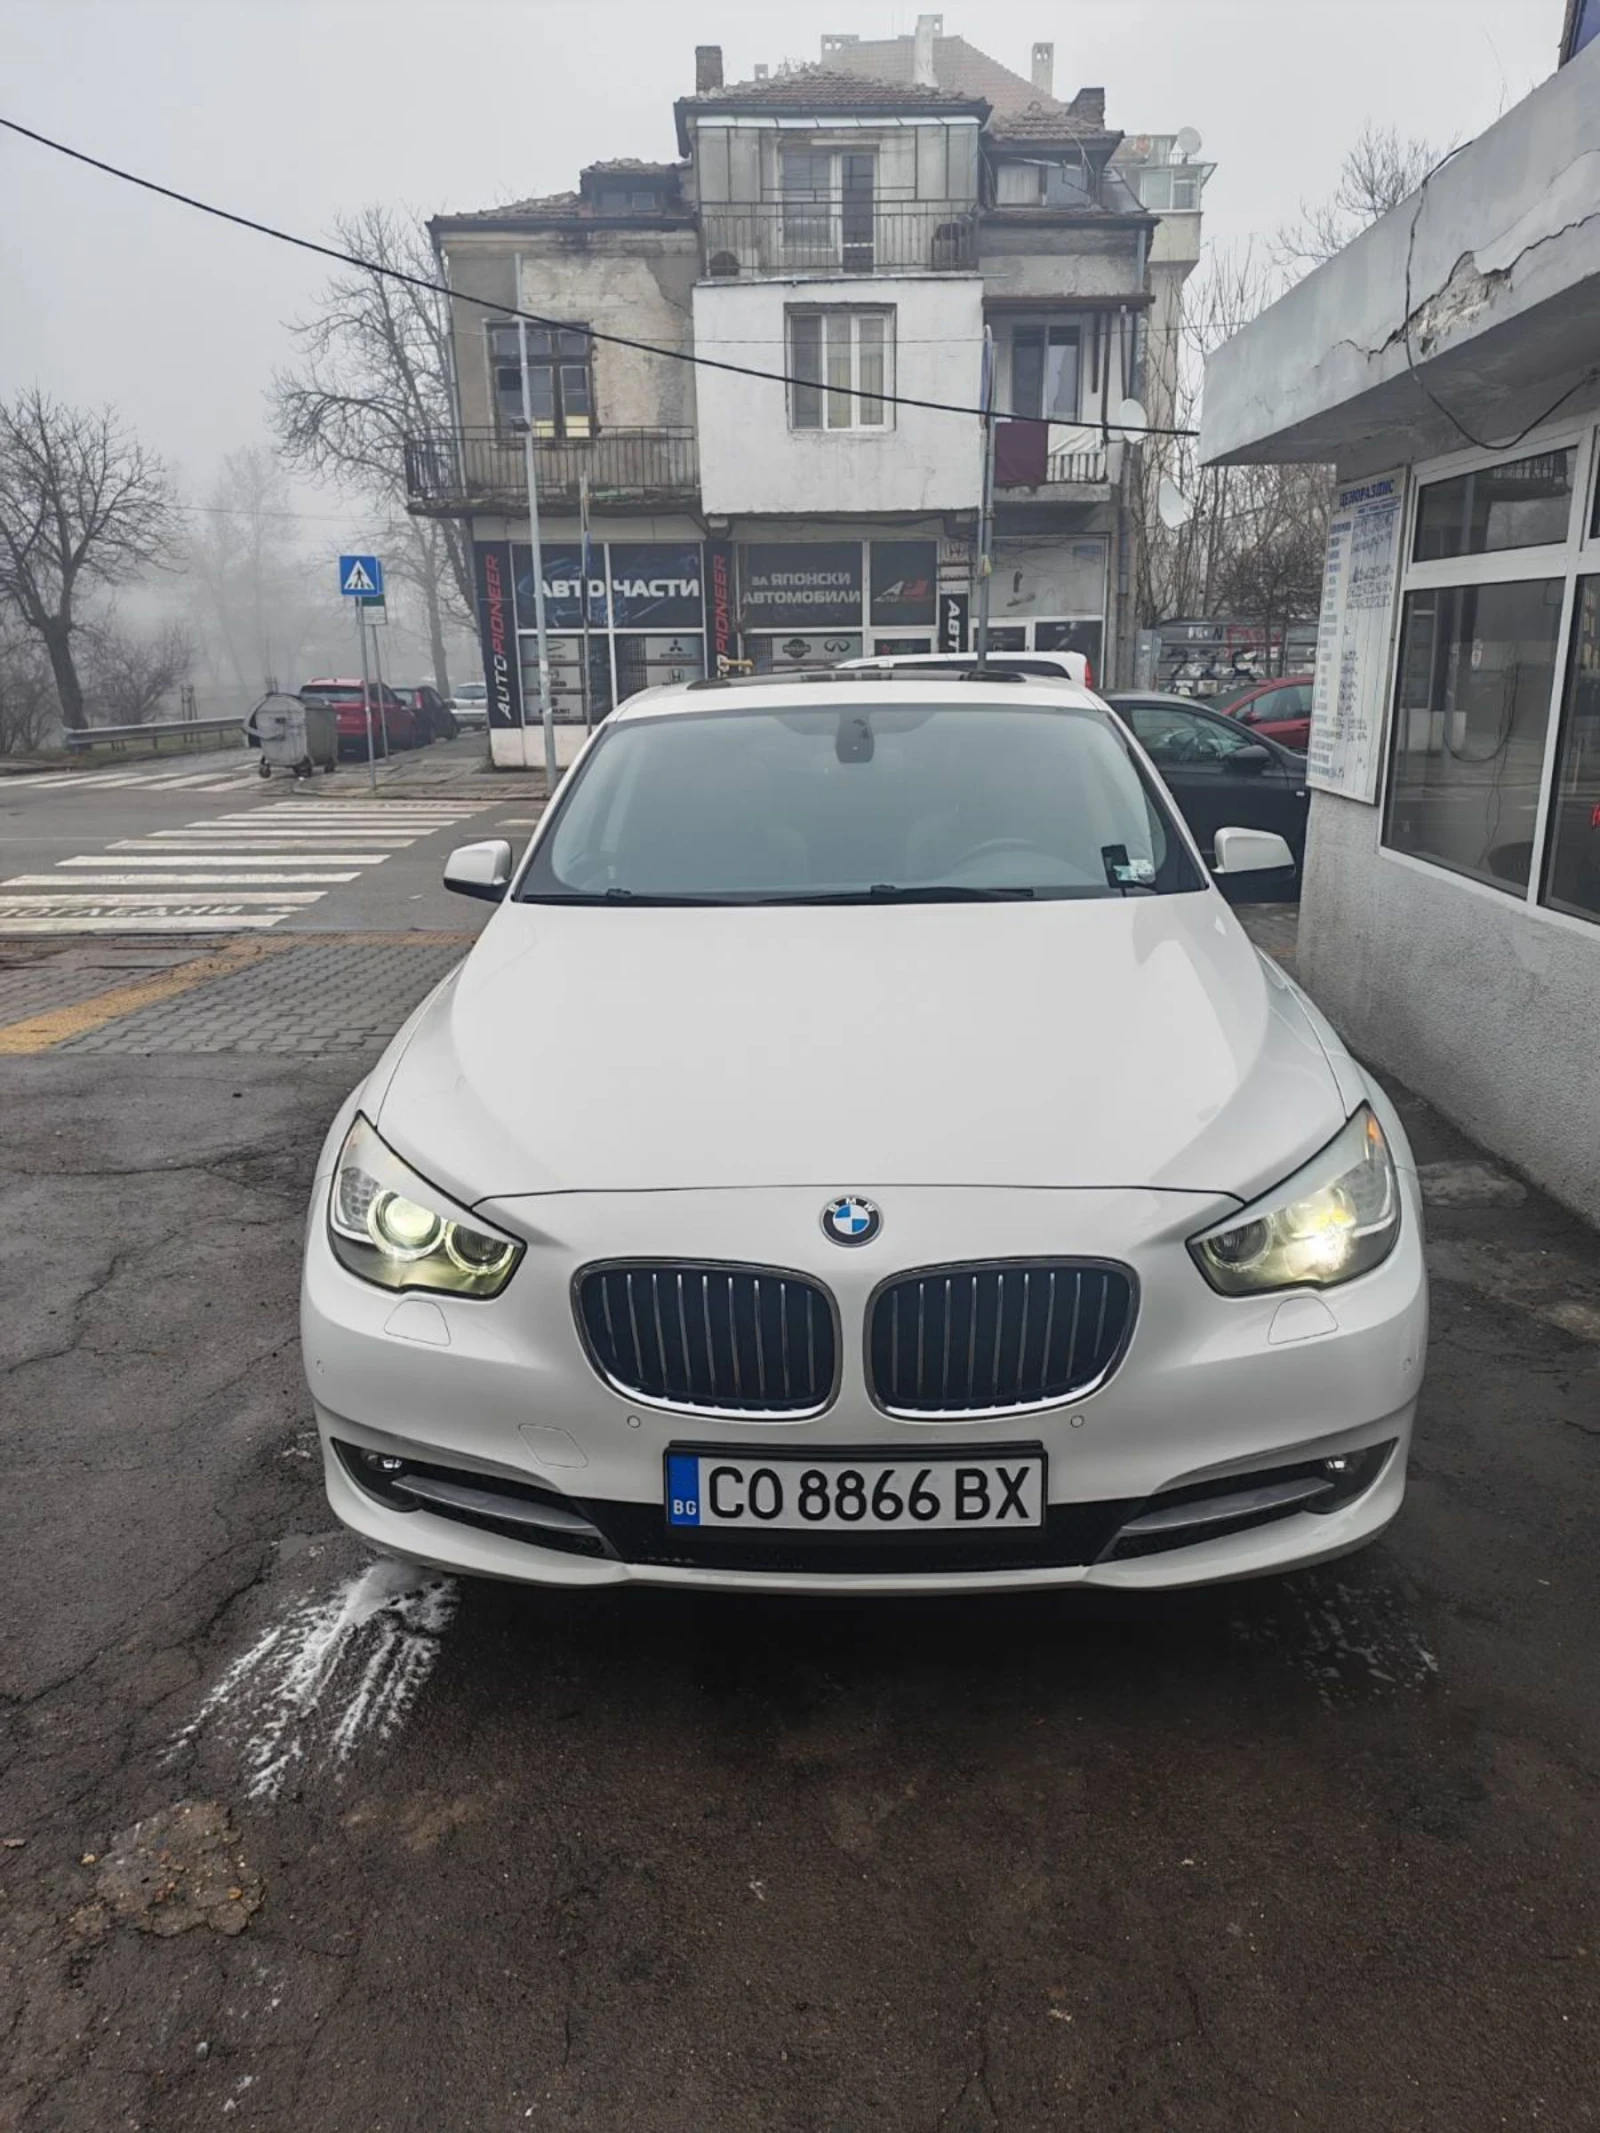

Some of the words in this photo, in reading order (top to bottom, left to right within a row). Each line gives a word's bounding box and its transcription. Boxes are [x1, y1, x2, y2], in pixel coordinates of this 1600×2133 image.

[743, 590, 861, 604] АВТОМОБИЛИ
[771, 573, 850, 586] ЯПОНСКИ
[486, 554, 511, 720] AUTOPIONEER
[948, 599, 961, 653] АВТ
[673, 1500, 697, 1516] BG
[798, 1469, 941, 1522] 8866
[955, 1466, 1031, 1520] BX
